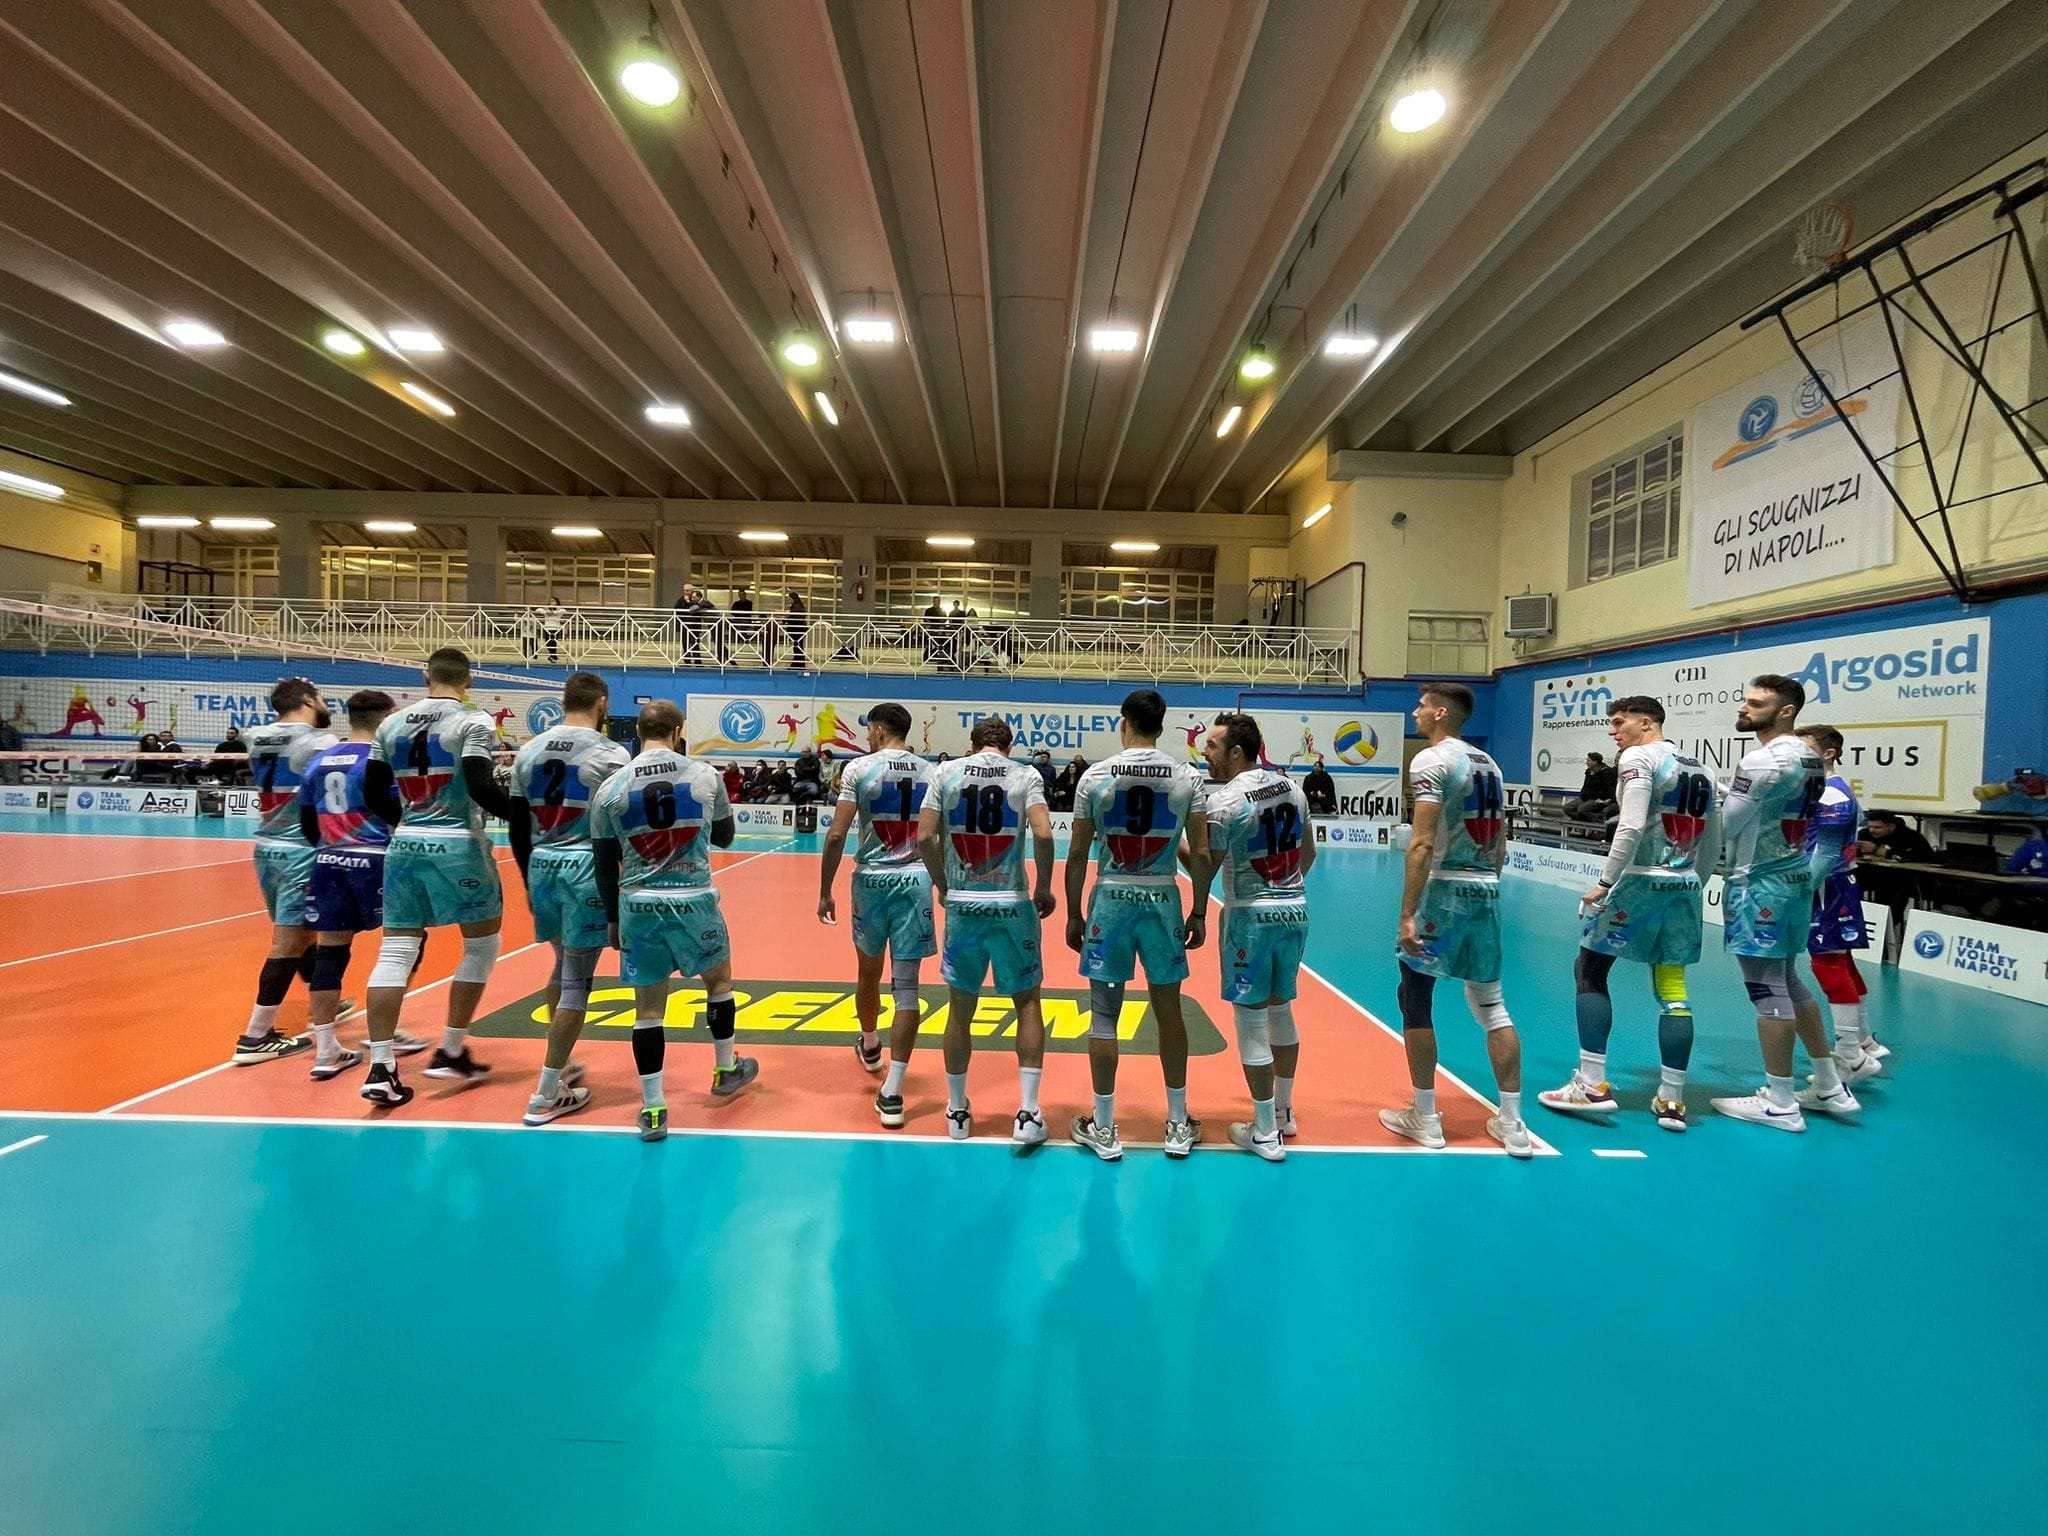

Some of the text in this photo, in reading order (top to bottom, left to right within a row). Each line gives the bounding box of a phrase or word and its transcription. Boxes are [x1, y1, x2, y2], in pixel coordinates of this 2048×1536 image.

[1714, 473, 1861, 545] GLI SCUGNIZZI
[1724, 550, 1742, 575] DI
[1674, 666, 1708, 683] cm
[1788, 634, 1979, 704] Argosid
[1898, 681, 1977, 699] Network
[194, 695, 257, 711] TEAM
[1030, 713, 1121, 732] VOLLEY
[1542, 717, 1612, 730] Rappresentanze
[1012, 730, 1083, 748] APOLI
[408, 730, 432, 776] 4
[259, 752, 279, 793] 7
[634, 761, 678, 777] PUTINI
[964, 765, 1007, 778] PETRONE
[1110, 764, 1173, 778] QUAGLIOZZI
[543, 758, 566, 806] 2
[139, 791, 188, 812] ARCI
[324, 771, 349, 815] 8
[897, 777, 912, 821] 1
[1676, 771, 1710, 818] 16
[642, 780, 677, 830] 6
[961, 784, 1004, 834] 18
[1126, 785, 1155, 836] 9
[1259, 802, 1297, 855] 12
[317, 854, 371, 868] LEOCATA
[1536, 855, 1578, 873] Salvatore
[630, 902, 693, 914] LEOCATA
[1958, 936, 2000, 954] TEAM
[1957, 947, 2018, 968] VOLLEY
[1955, 958, 2017, 981] NAPOLI
